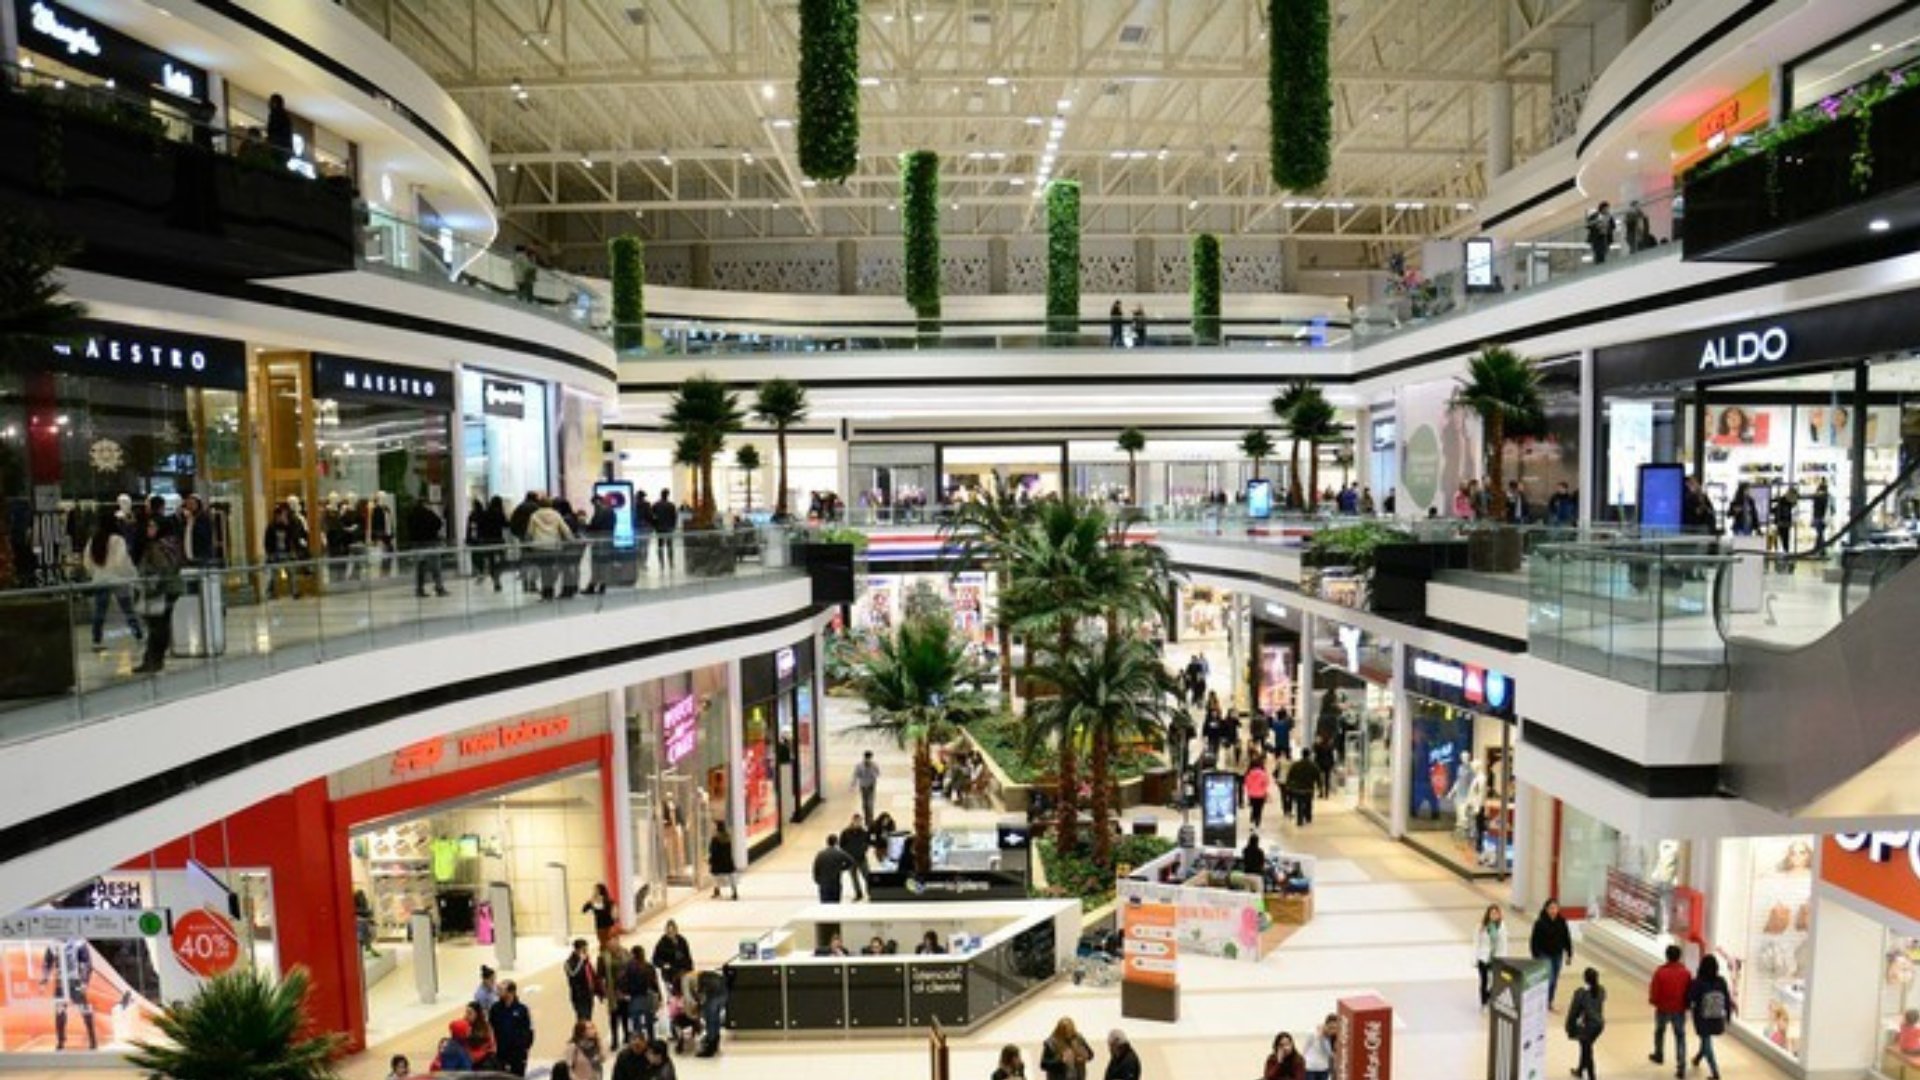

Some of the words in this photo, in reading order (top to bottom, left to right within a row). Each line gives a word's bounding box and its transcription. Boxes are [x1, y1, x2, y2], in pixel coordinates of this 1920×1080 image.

[1699, 327, 1787, 369] ALDO
[344, 371, 435, 397] MAESTRO
[460, 731, 499, 756] new
[499, 714, 570, 748] balance
